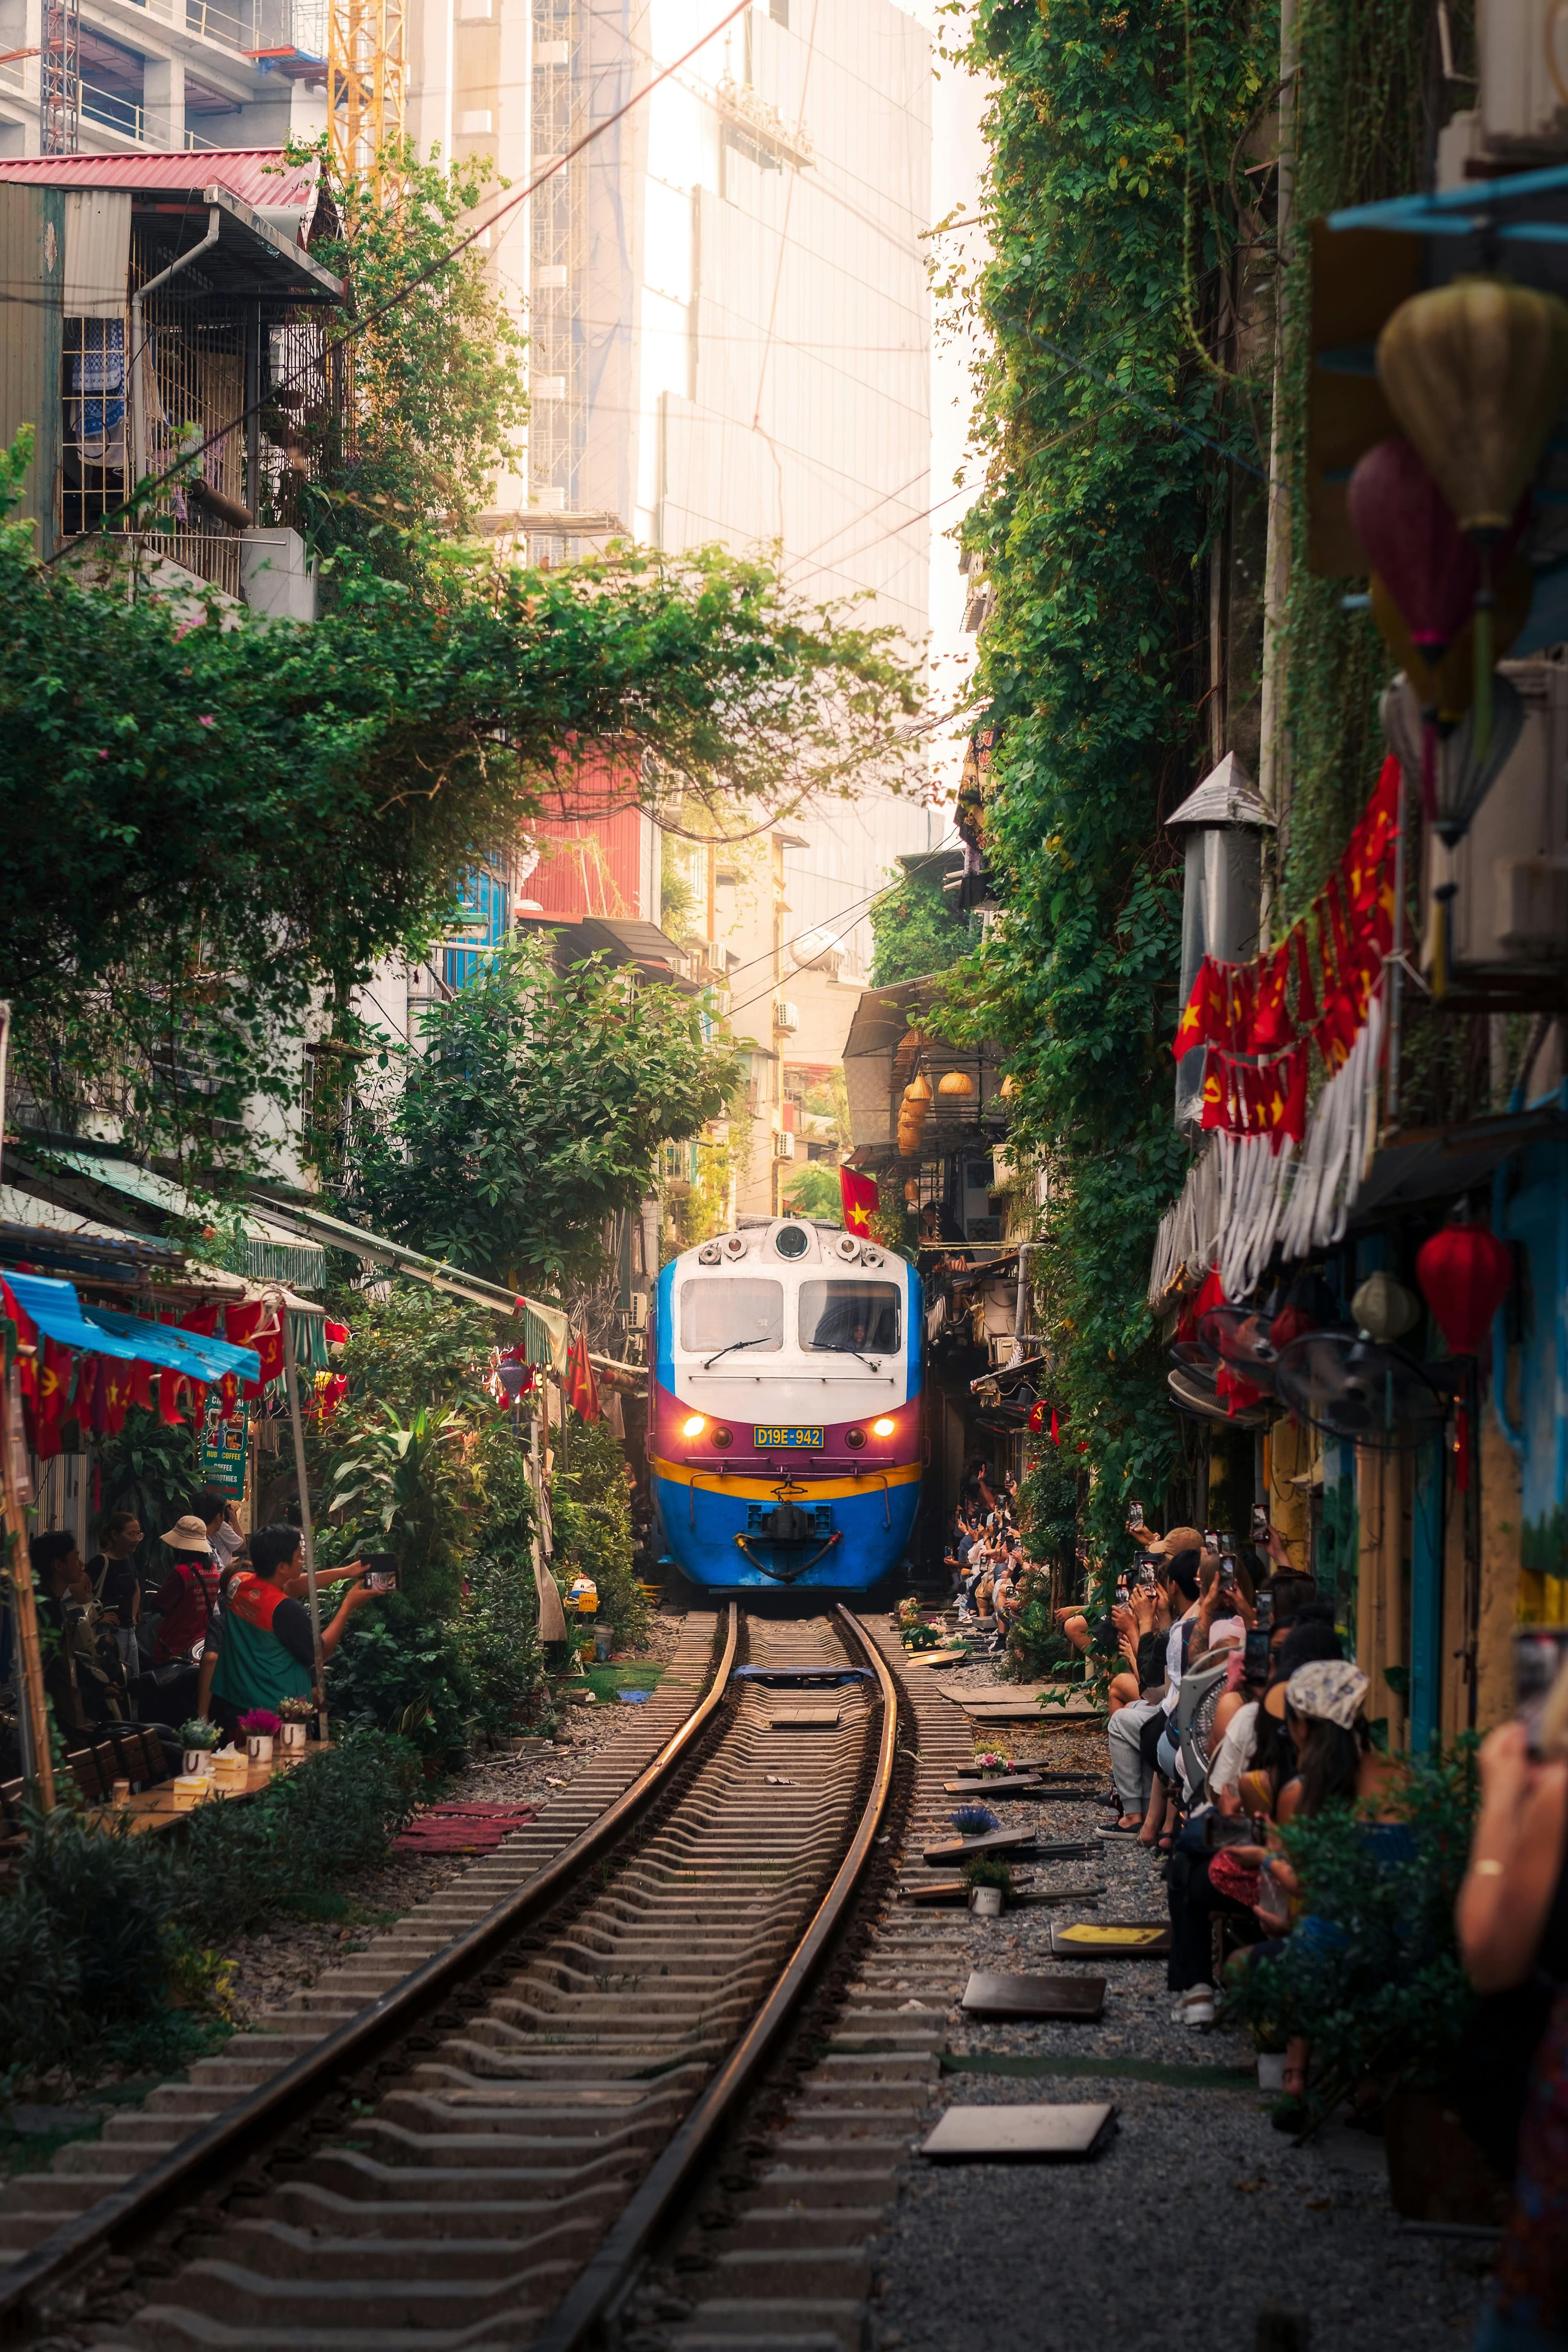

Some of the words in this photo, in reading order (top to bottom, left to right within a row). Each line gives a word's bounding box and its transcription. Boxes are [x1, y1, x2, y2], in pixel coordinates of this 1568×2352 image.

[758, 1429, 820, 1444] D19E-942
[222, 1452, 241, 1460] COFFEE
[207, 1473, 237, 1482] SMOOTHIES
